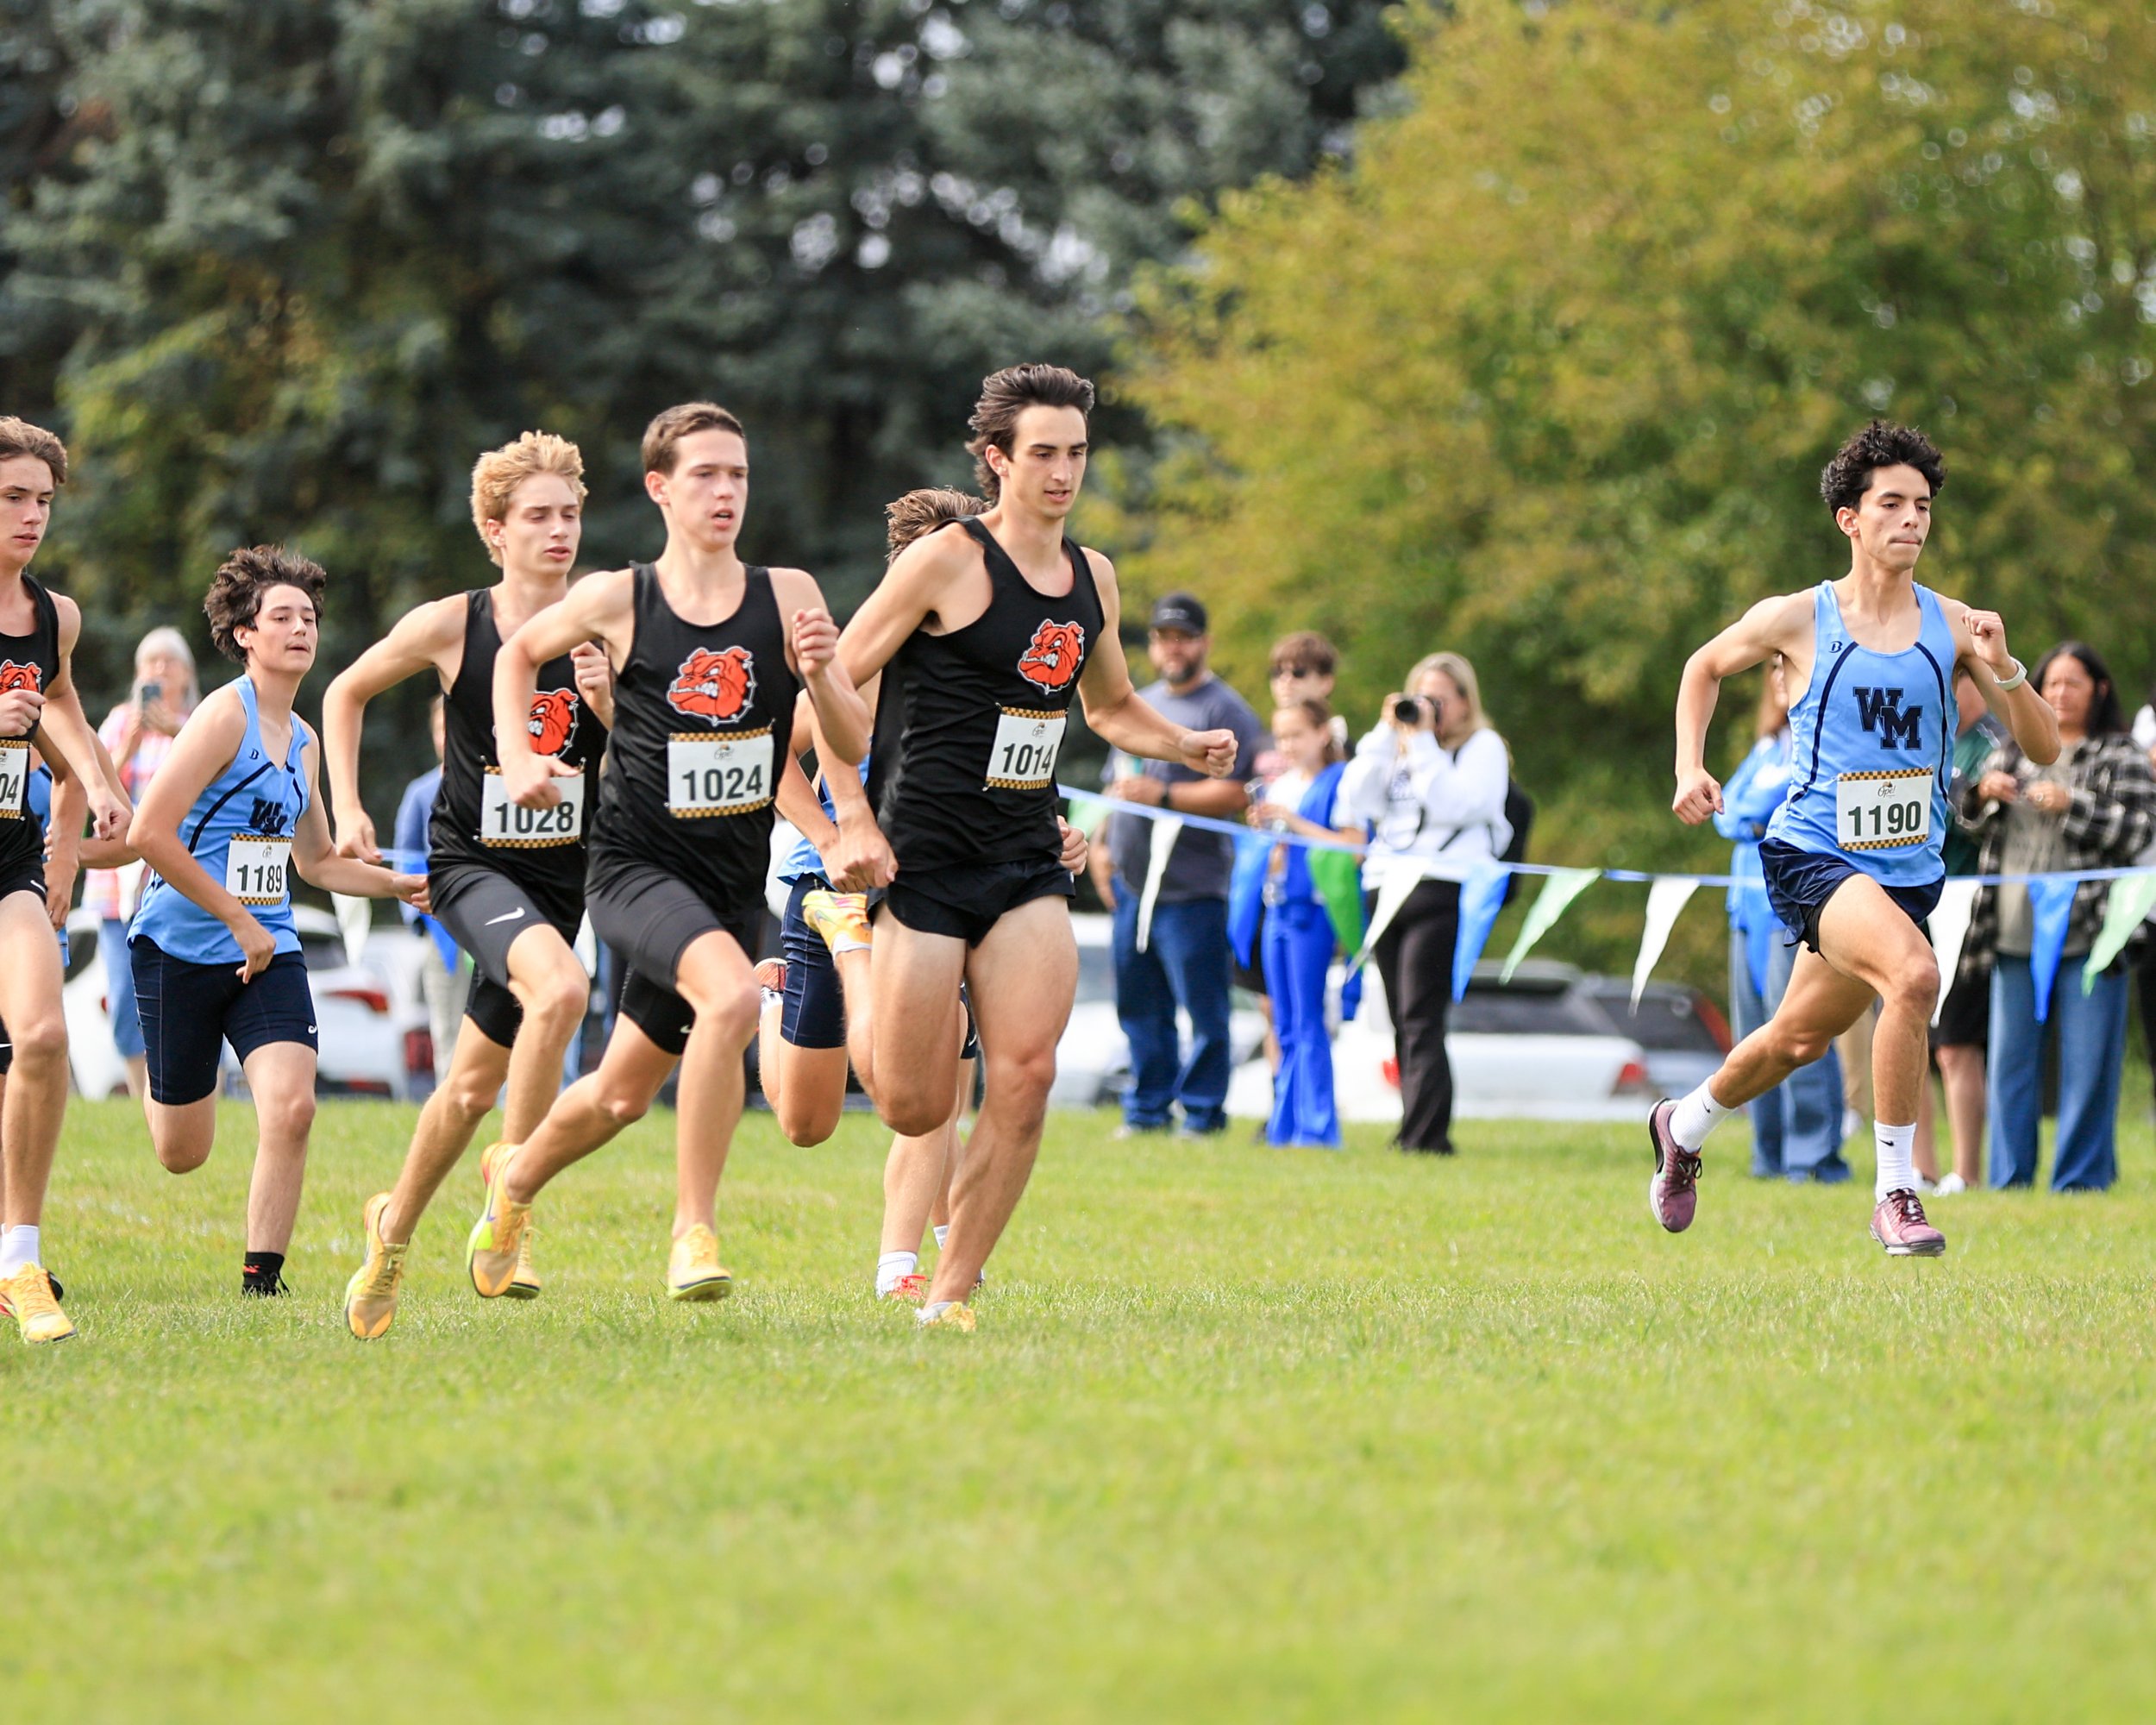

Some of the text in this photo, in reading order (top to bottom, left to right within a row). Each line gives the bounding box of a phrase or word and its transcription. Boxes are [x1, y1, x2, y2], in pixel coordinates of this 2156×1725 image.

[1852, 687, 1923, 750] WM
[1003, 743, 1054, 775] 1014
[682, 764, 762, 800] 1024
[495, 801, 573, 833] 1028
[1848, 800, 1921, 836] 1190
[237, 864, 282, 892] 1189
